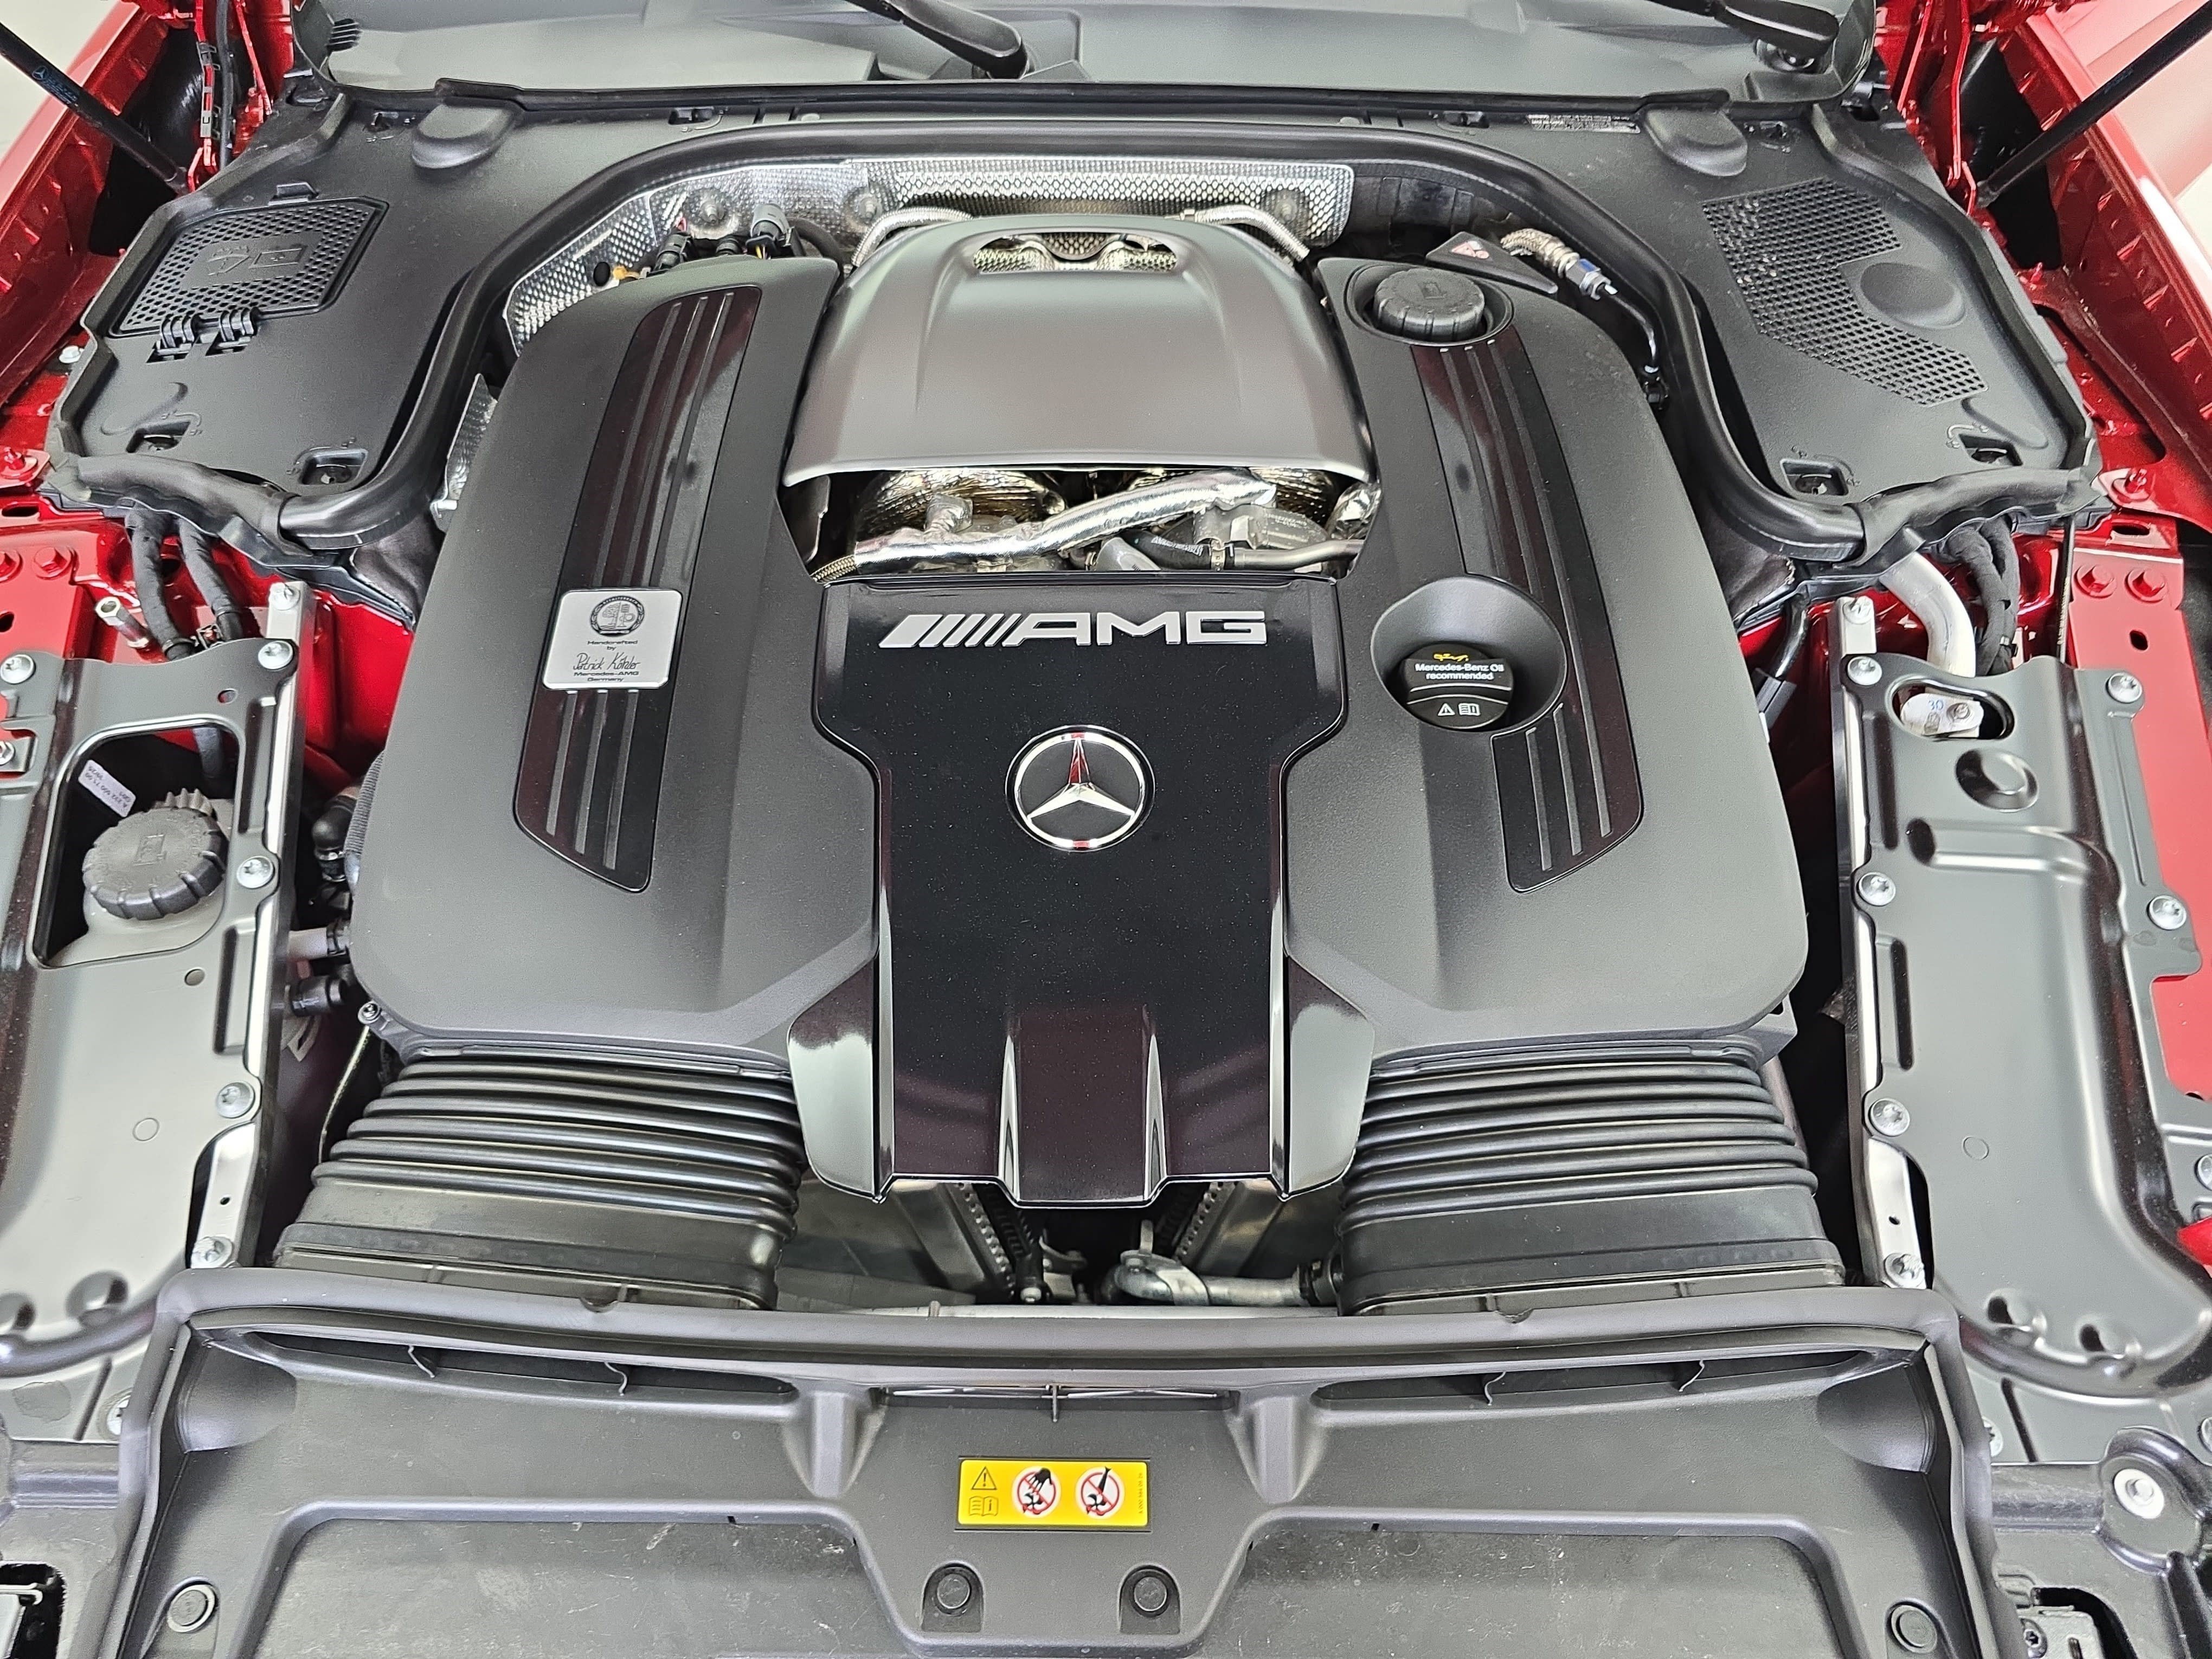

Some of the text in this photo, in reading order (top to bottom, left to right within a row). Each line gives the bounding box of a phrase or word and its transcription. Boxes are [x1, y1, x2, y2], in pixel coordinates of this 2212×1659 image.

[1002, 611, 1266, 646] AMG
[1415, 663, 1504, 672] Mercedes-Benz Oil
[1426, 672, 1494, 680] recommended
